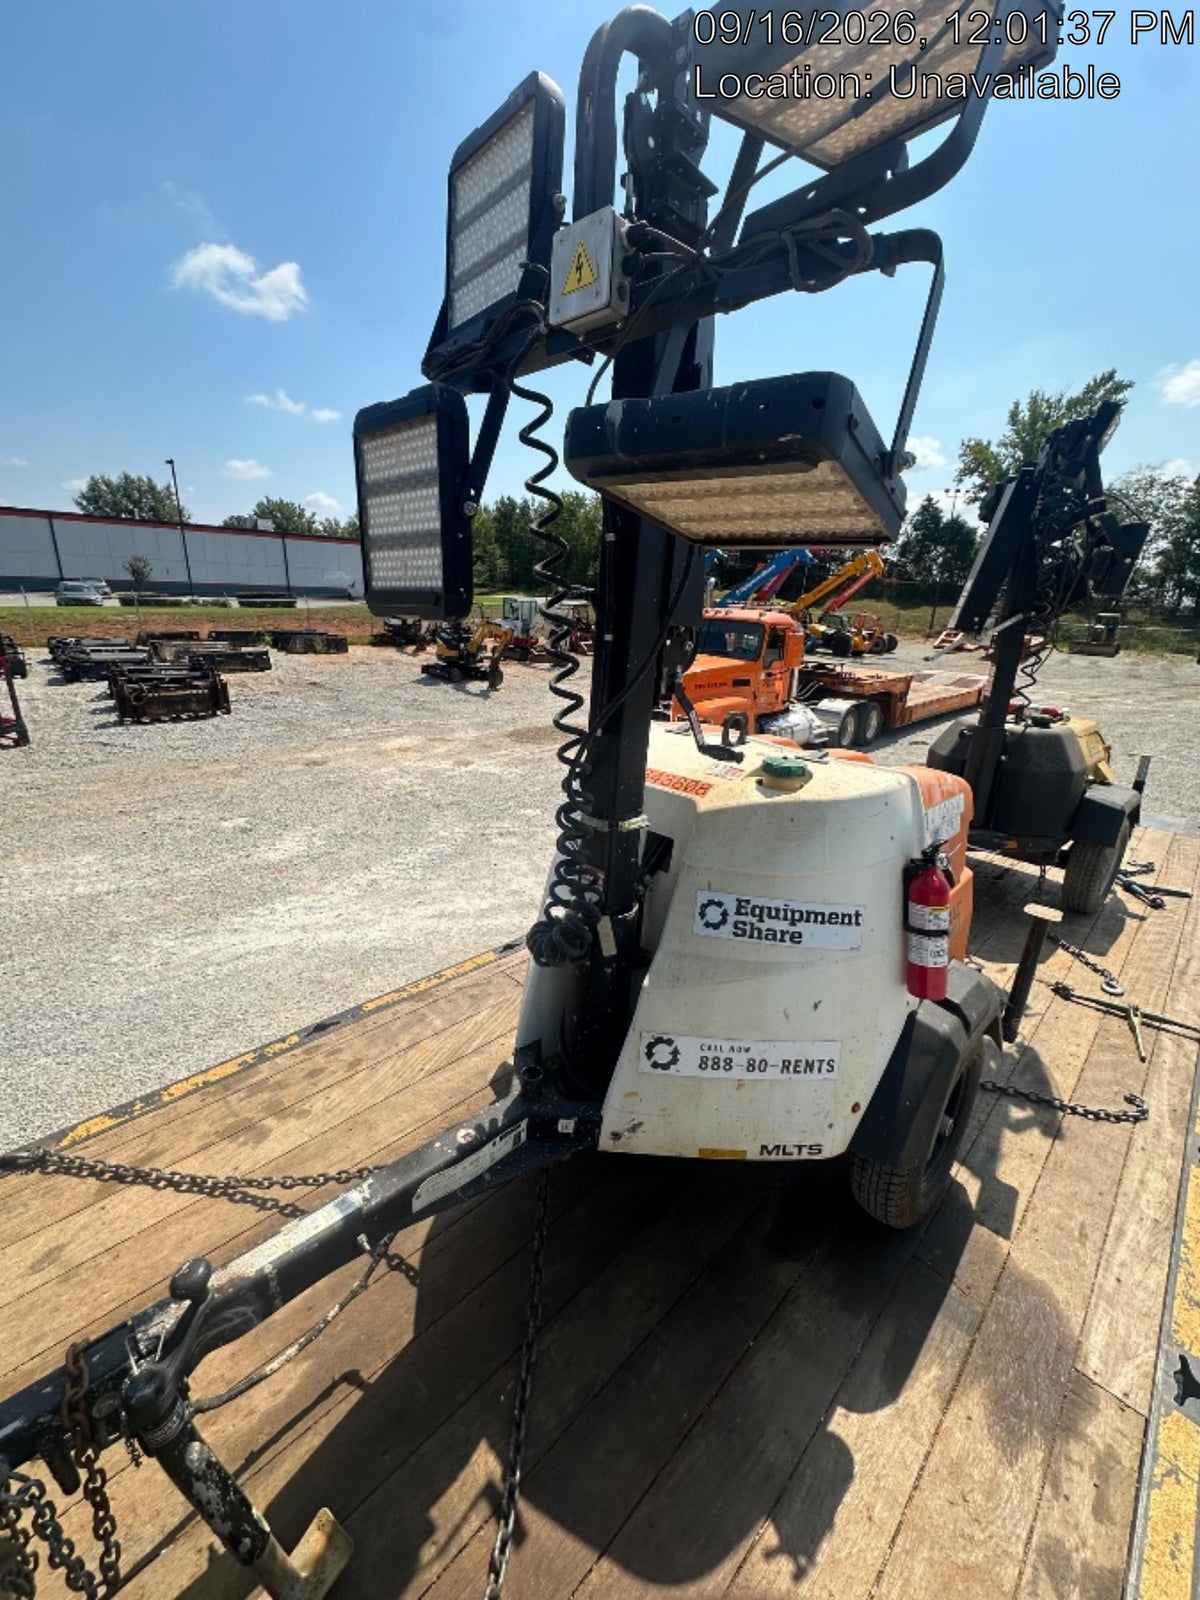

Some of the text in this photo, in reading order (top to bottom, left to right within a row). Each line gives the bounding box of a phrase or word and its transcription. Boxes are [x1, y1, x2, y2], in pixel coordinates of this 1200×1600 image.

[734, 898, 863, 926] Equipment
[732, 920, 803, 944] Share
[700, 1043, 751, 1053] CALL NOW
[698, 1055, 835, 1075] 888-80-RENTS
[760, 1144, 823, 1156] MLTS
